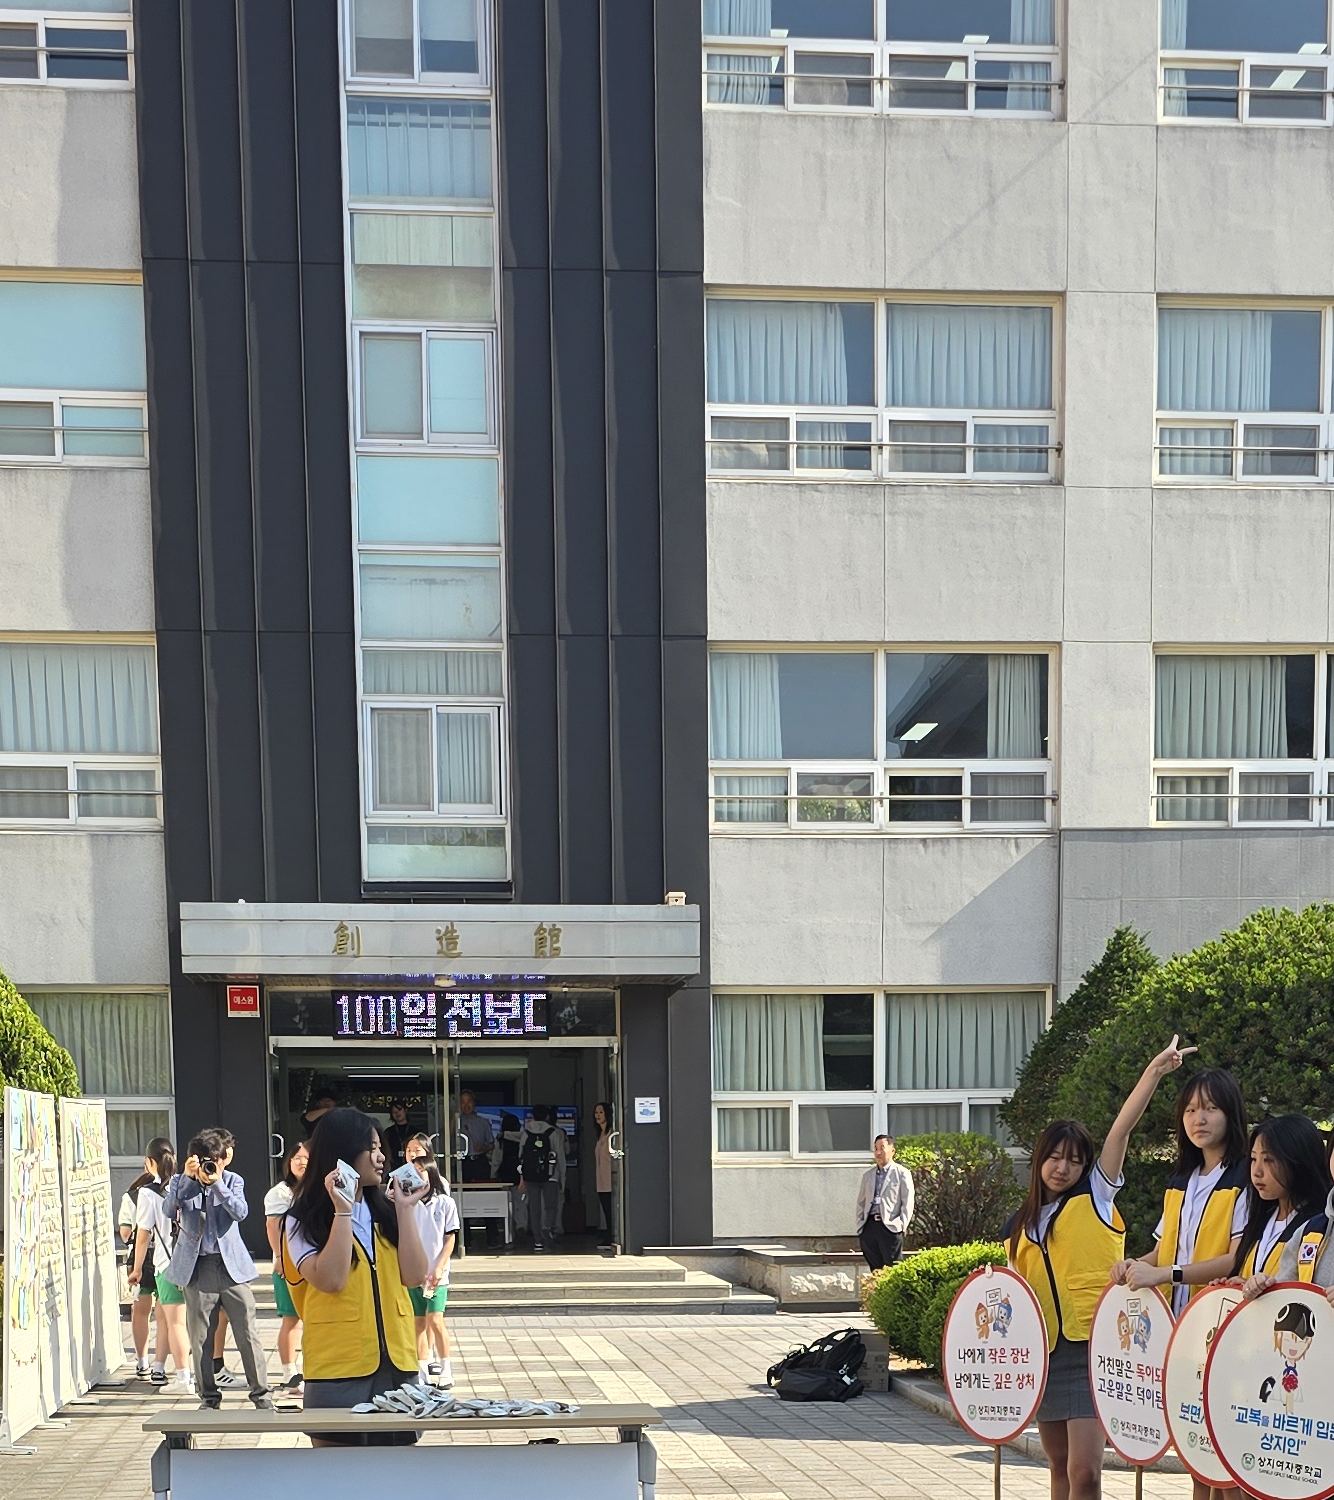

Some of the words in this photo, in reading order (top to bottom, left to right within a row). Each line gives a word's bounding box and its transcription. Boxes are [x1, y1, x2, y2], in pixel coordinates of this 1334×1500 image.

[332, 921, 562, 958] 創造館
[336, 992, 437, 1037] 100일
[958, 1348, 986, 1365] 나에게
[988, 1348, 1008, 1365] 작은
[1010, 1348, 1031, 1365] 장난
[1097, 1354, 1135, 1380] 거친말은
[954, 1373, 991, 1390] 남에게는
[993, 1373, 1013, 1390] 깊은
[1015, 1373, 1036, 1390] 상처
[1097, 1377, 1134, 1403] 고운말은
[978, 1405, 1022, 1416] 상지여자중학교
[1120, 1420, 1161, 1440] 상지여자중학교
[1272, 1412, 1314, 1437] 바르게
[1257, 1456, 1322, 1479] 상지여자중학교
